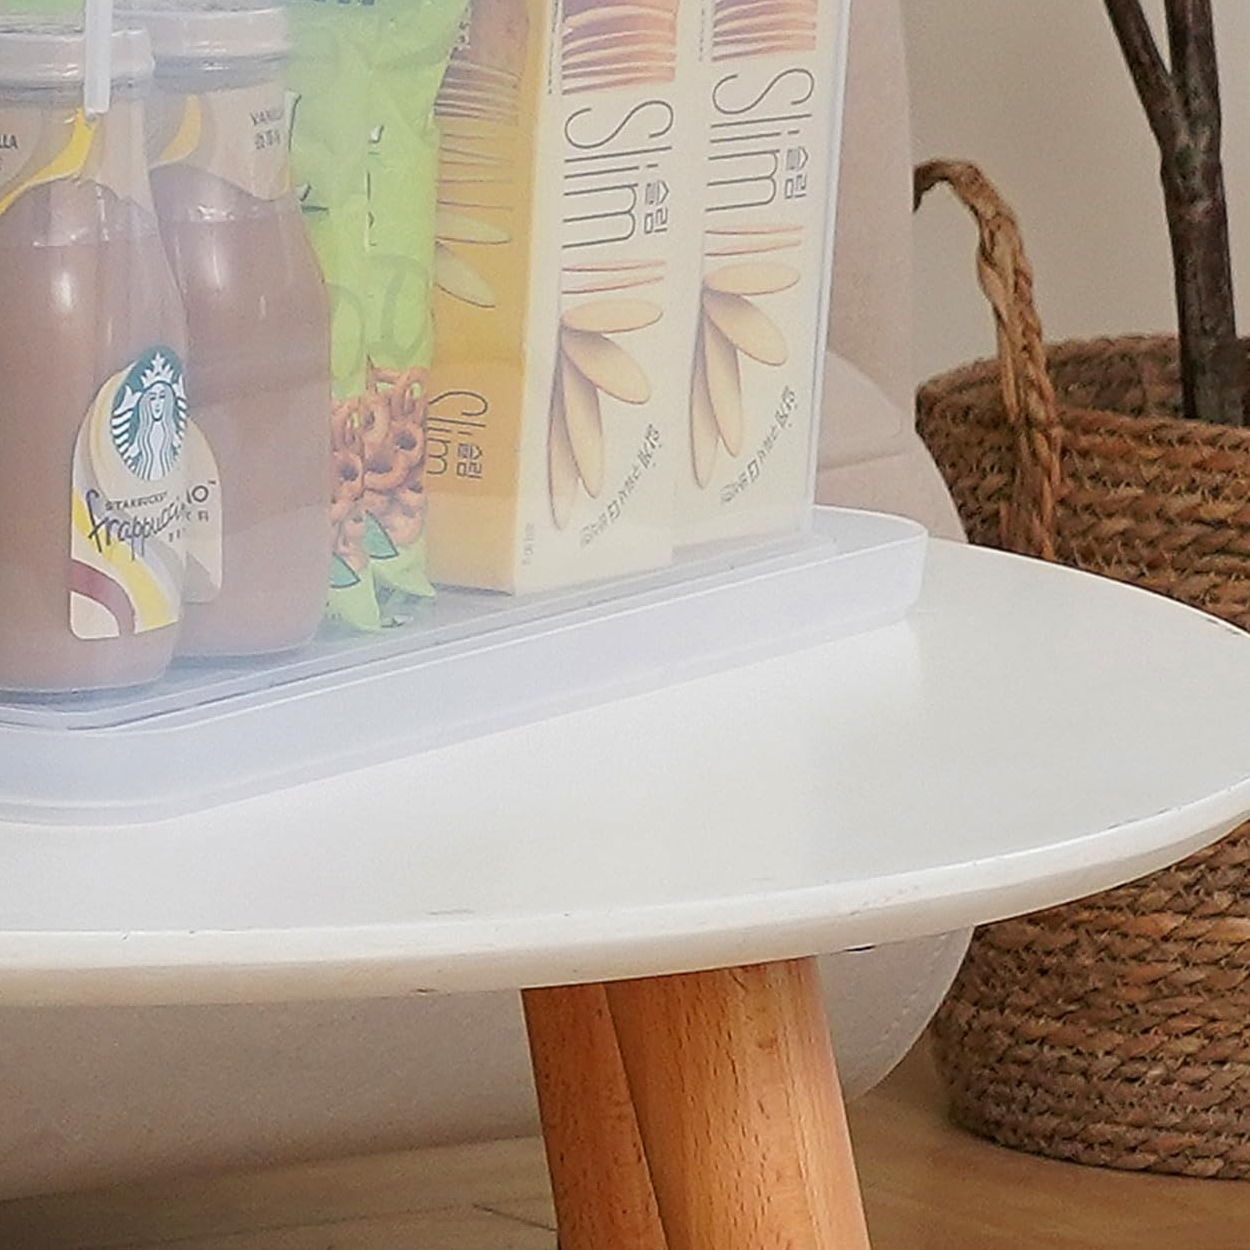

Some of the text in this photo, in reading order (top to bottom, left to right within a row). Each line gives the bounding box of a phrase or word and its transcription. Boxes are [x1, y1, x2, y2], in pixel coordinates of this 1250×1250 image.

[562, 100, 675, 249] Slim
[706, 68, 814, 212] Slim
[784, 147, 808, 199] 슬림
[644, 180, 669, 234] 슬림
